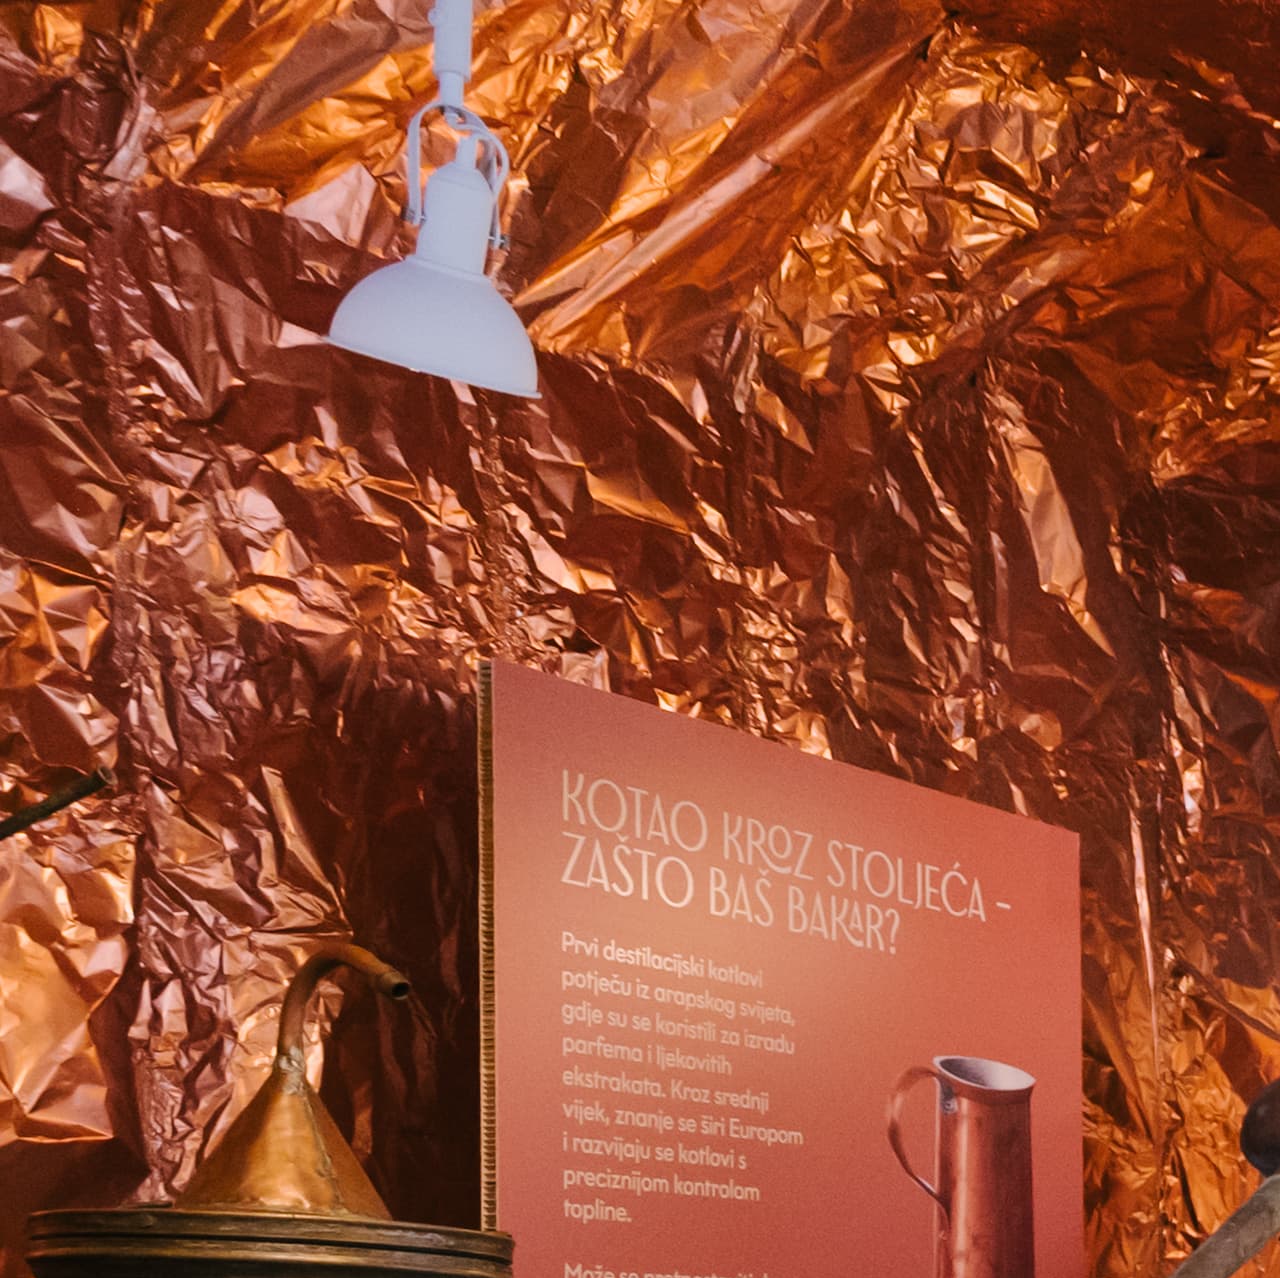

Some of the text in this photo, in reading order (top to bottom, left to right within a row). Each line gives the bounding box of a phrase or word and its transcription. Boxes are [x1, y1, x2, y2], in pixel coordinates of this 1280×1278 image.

[562, 769, 708, 852] KOTAO
[723, 811, 814, 880] KROZ
[827, 839, 986, 922] STOLJEĆA
[560, 831, 901, 955] ZAŠTO BAŠ BAKAR?
[561, 931, 762, 984] Prvi destilacijski kotlovi
[561, 971, 795, 1024] potječu iz arapskog svijeta,
[560, 1001, 796, 1053] gdje su se koristili za izradu
[561, 1035, 733, 1072] parfema i ljekovitih
[561, 1066, 770, 1112] ekstrakata. Kroz srednji
[562, 1099, 804, 1144] vijek, znanje se širi Europom
[562, 1132, 748, 1170] i razvijaju se kotlovi s
[562, 1169, 761, 1199] preciznijom kontrolom
[563, 1199, 633, 1222] topline.
